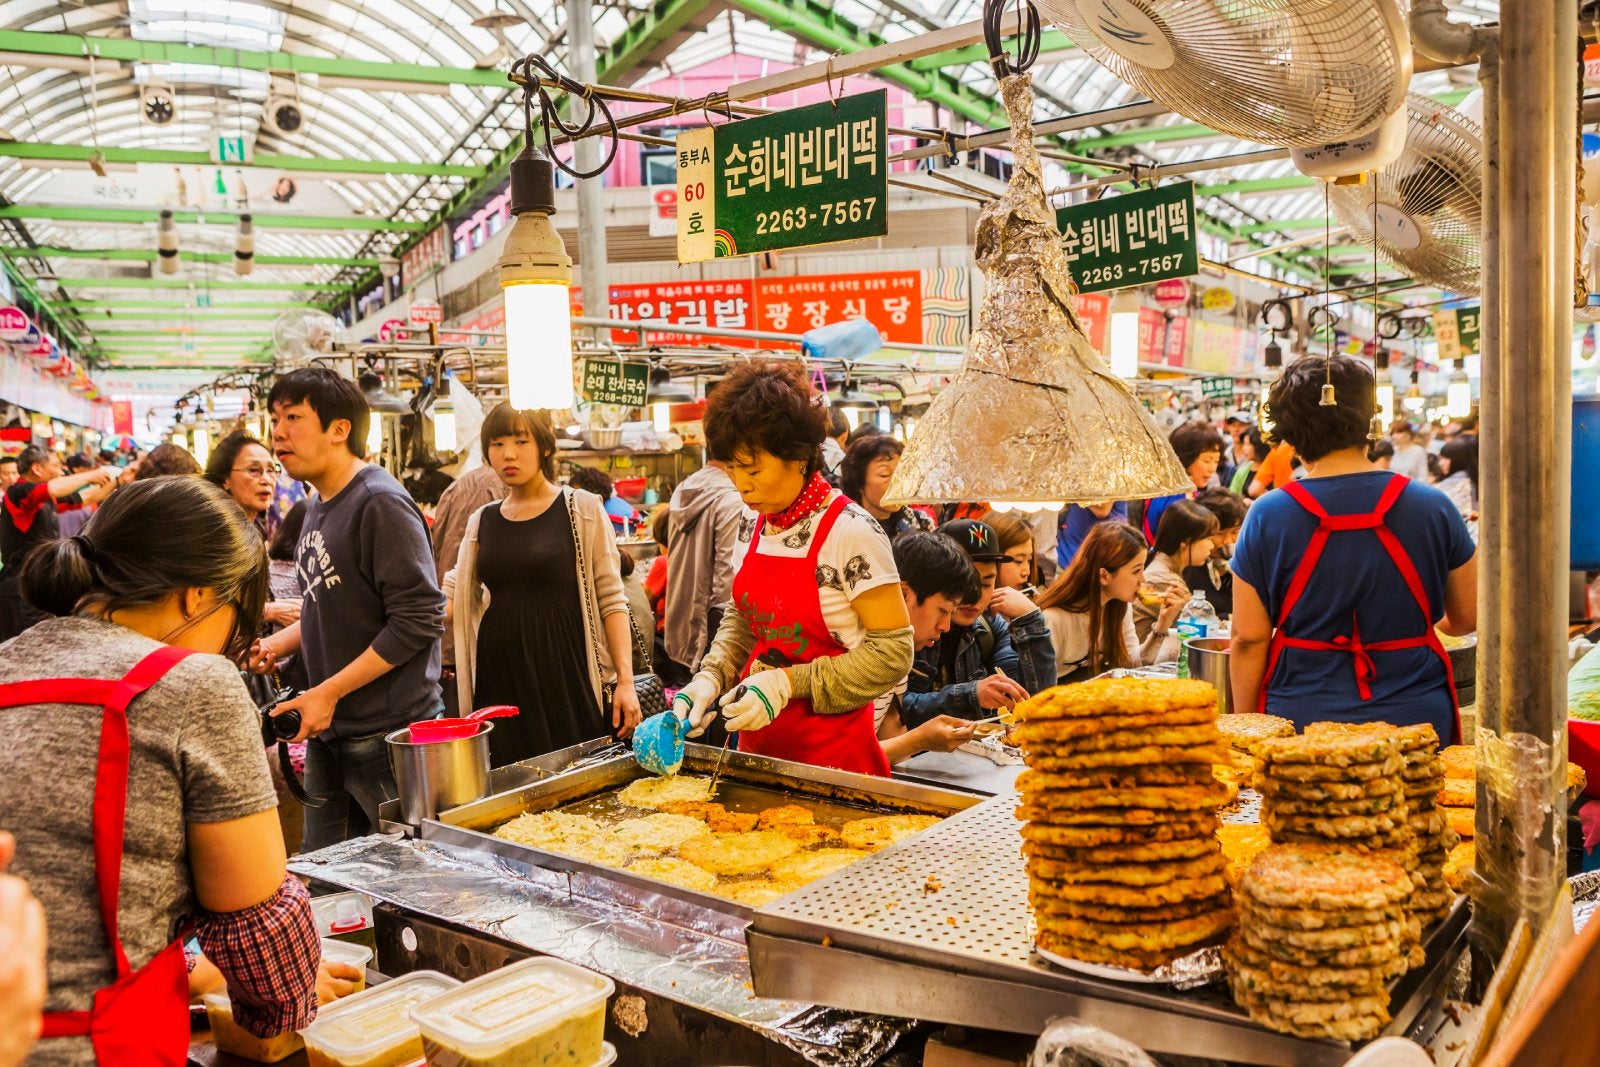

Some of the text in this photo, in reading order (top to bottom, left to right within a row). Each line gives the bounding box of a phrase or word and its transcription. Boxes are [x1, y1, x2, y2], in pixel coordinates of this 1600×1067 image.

[679, 146, 710, 168] 동부A
[724, 116, 877, 198] 순희네빈대떡
[684, 182, 705, 201] 60
[687, 212, 704, 235] 호
[756, 197, 877, 235] 2263-7567
[1061, 199, 1190, 262] 순희네 빈대떡
[588, 362, 616, 375] 하니네
[586, 374, 605, 390] 순대
[594, 391, 643, 405] 2268-6738
